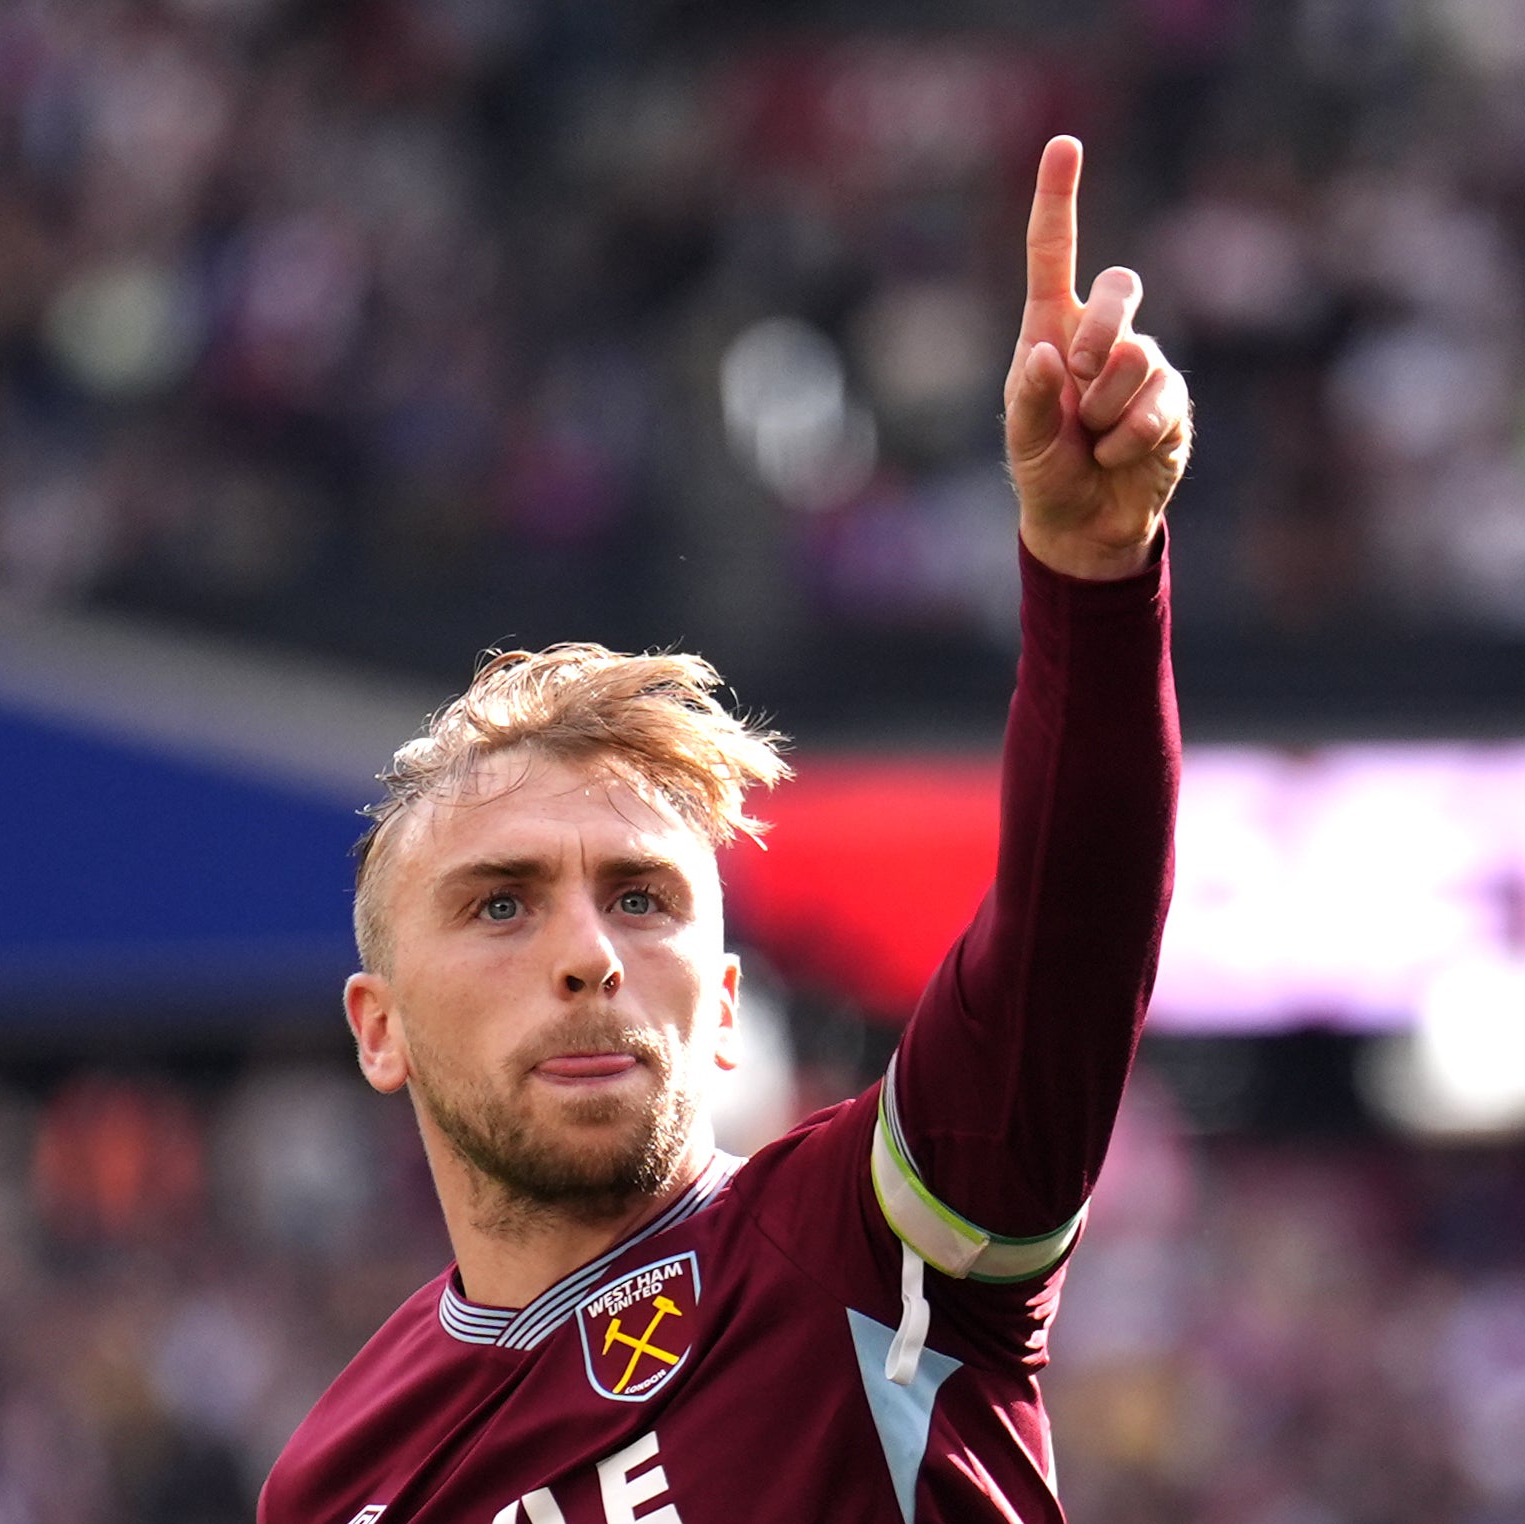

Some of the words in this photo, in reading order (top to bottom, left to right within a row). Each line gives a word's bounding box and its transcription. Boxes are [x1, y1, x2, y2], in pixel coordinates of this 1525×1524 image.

[587, 1280, 634, 1319] WEST
[637, 1262, 683, 1293] HAM
[607, 1282, 664, 1317] UNITED
[623, 1368, 667, 1395] LONDON
